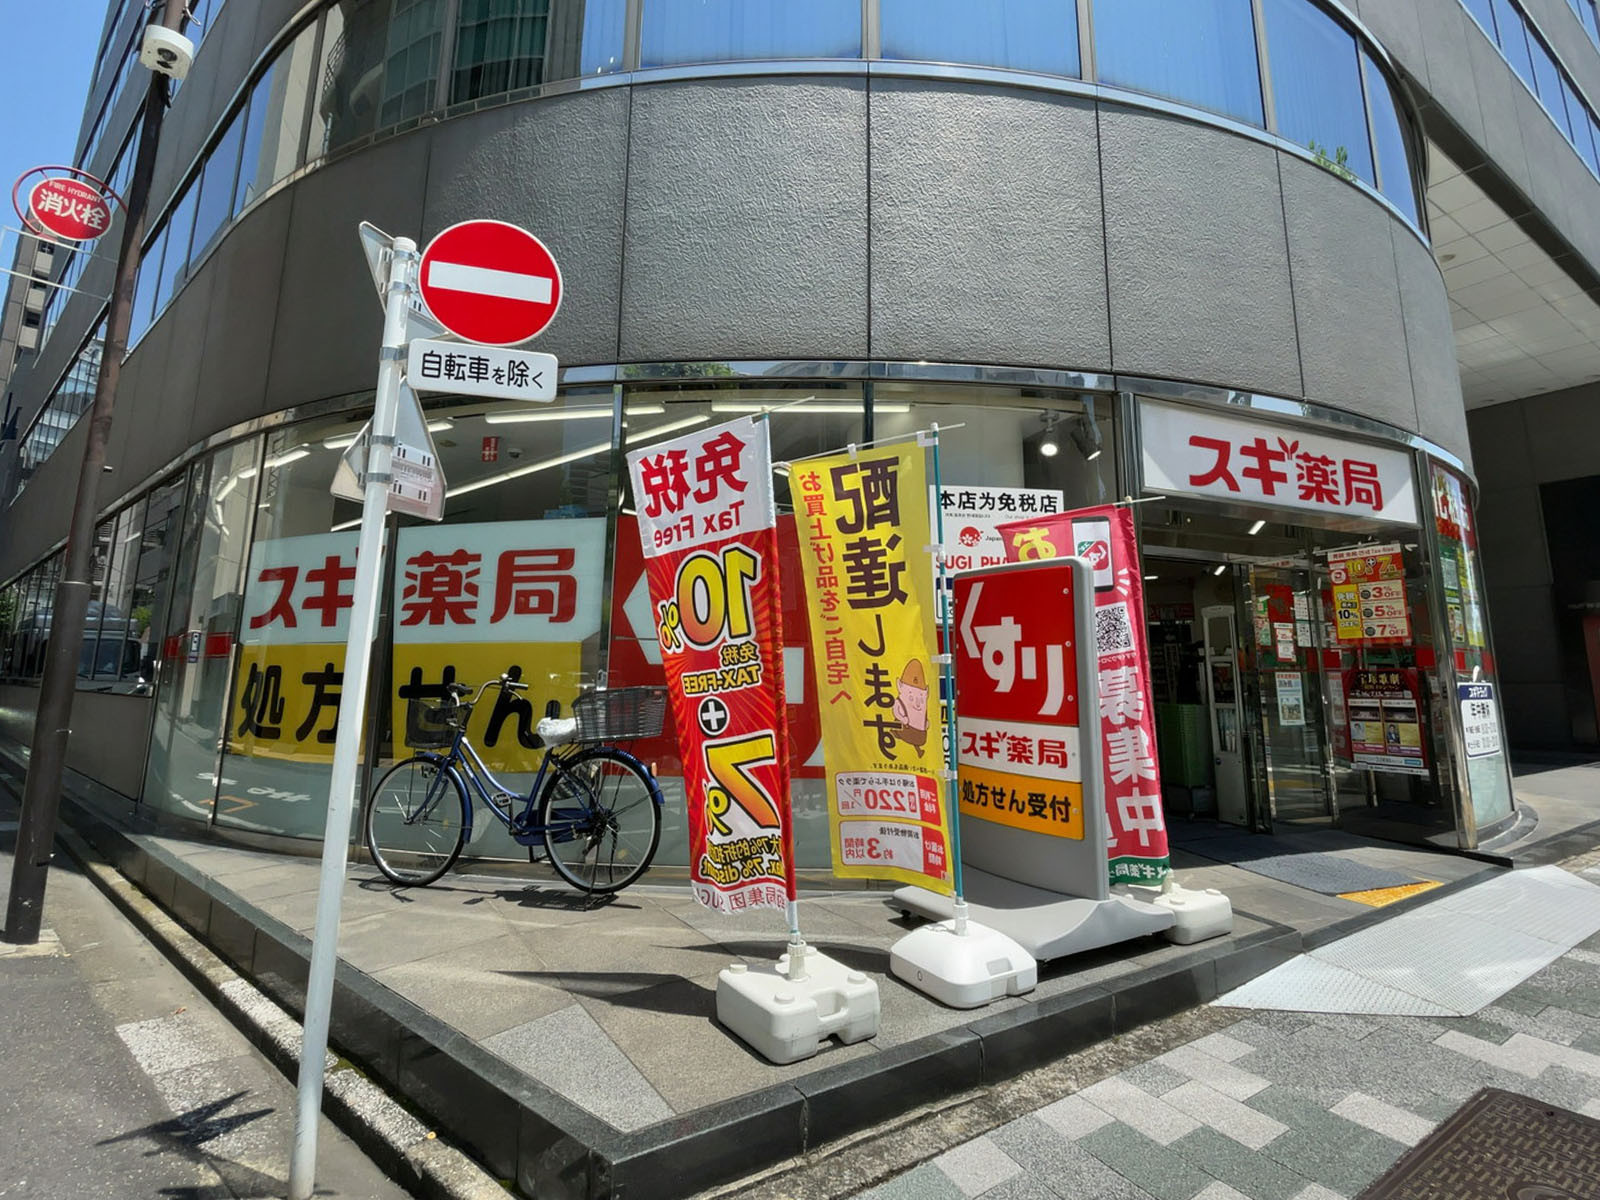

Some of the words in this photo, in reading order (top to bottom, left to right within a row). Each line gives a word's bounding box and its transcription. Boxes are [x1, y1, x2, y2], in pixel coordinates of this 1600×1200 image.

[38, 188, 106, 230] 消火栓
[48, 181, 67, 192] FIRE
[67, 187, 101, 203] HYDRANT
[421, 350, 544, 389] 自転車を除く
[1188, 436, 1383, 512] スギ薬局
[939, 490, 1058, 513] 本店为免税店
[960, 581, 1064, 716] くすり
[962, 731, 1068, 769] スギ薬局
[962, 779, 1071, 823] 処方せん受付
